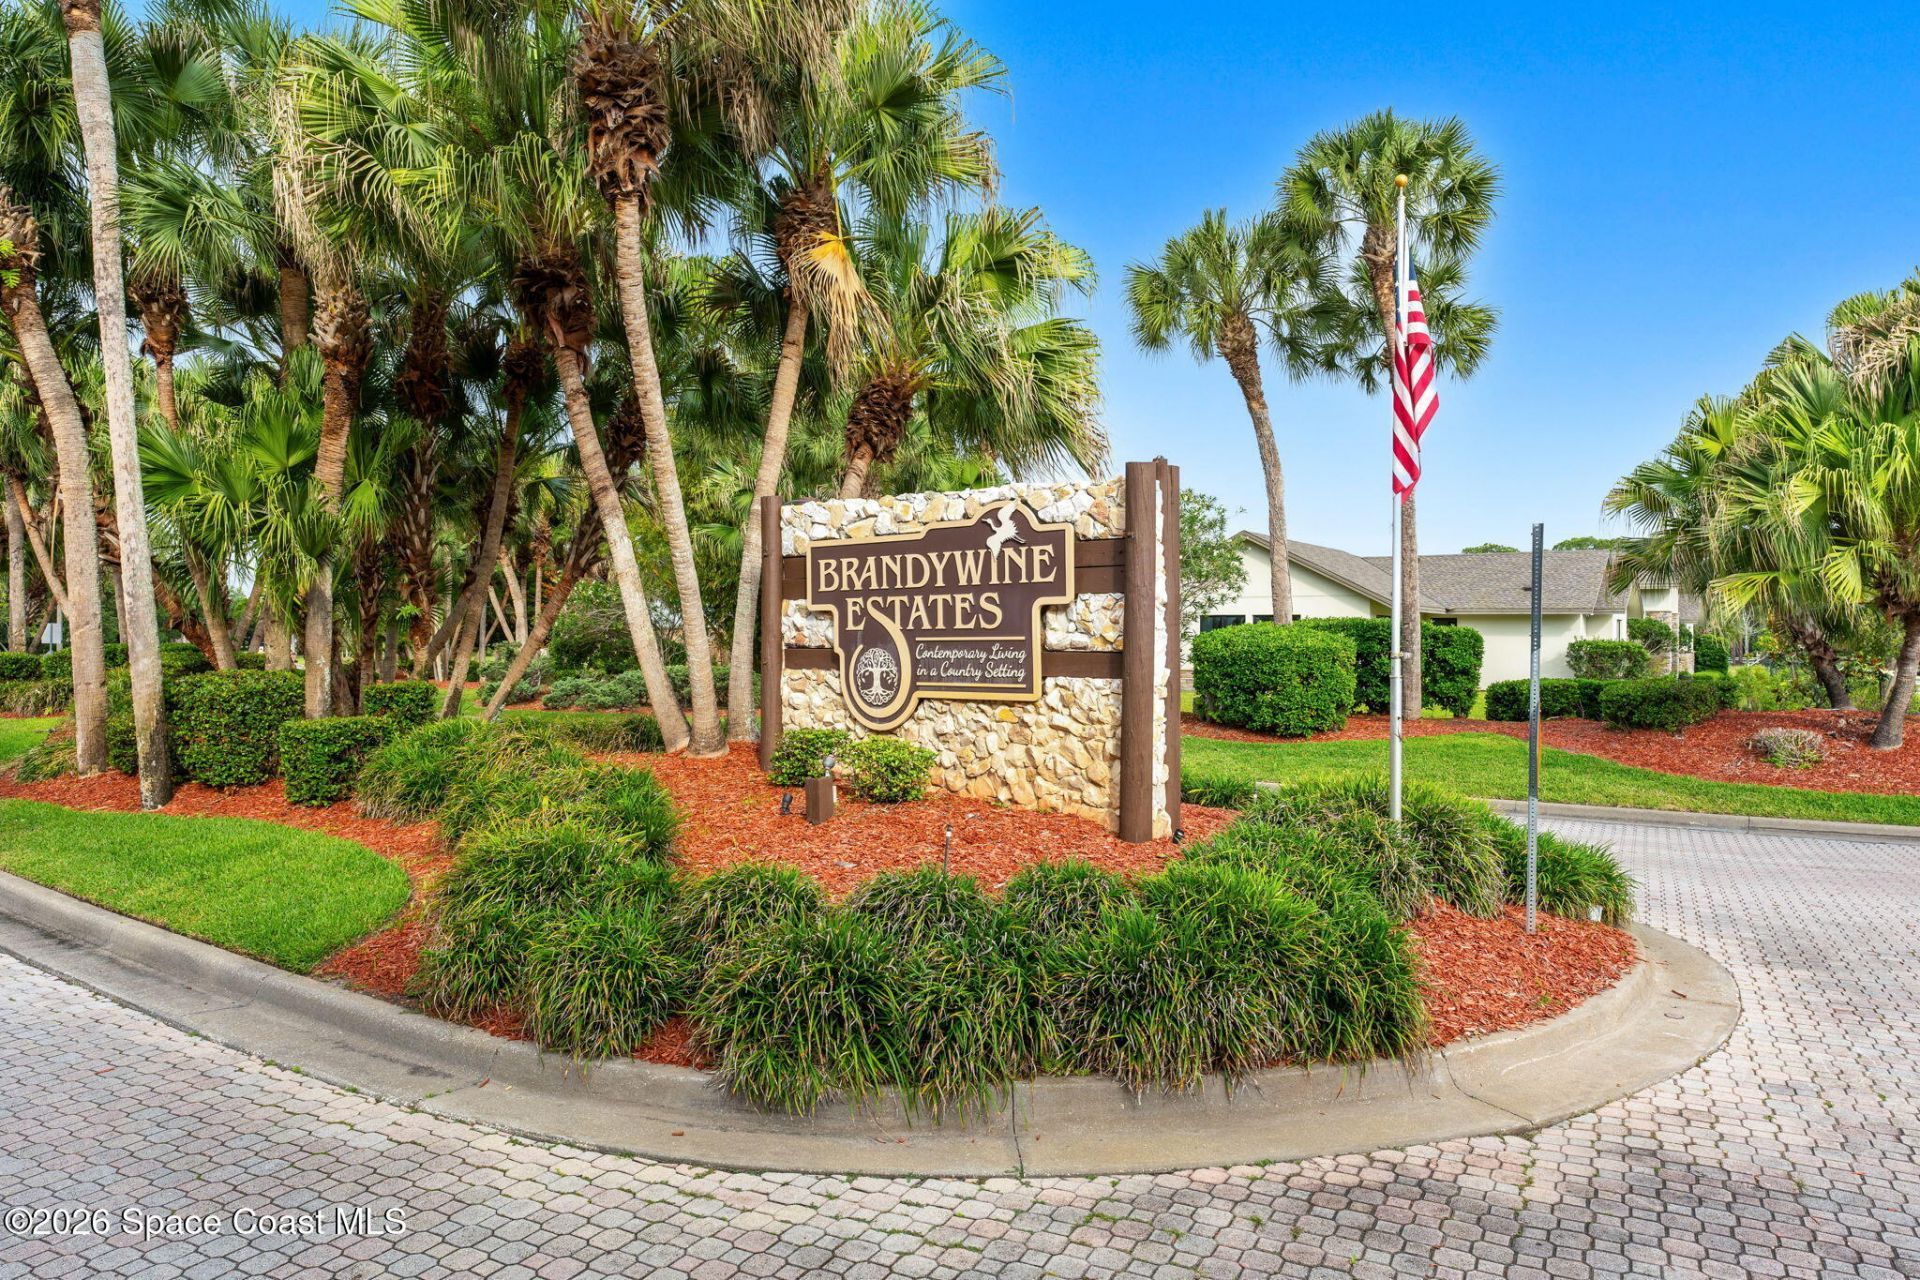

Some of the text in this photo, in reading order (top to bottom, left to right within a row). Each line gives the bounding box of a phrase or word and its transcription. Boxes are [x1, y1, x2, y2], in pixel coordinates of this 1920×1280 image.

[818, 544, 1057, 592] BRANDYWINE
[845, 592, 1003, 631] ESTATES
[915, 643, 1027, 663] Contemporary Living
[916, 661, 1026, 682] in a Country Setting
